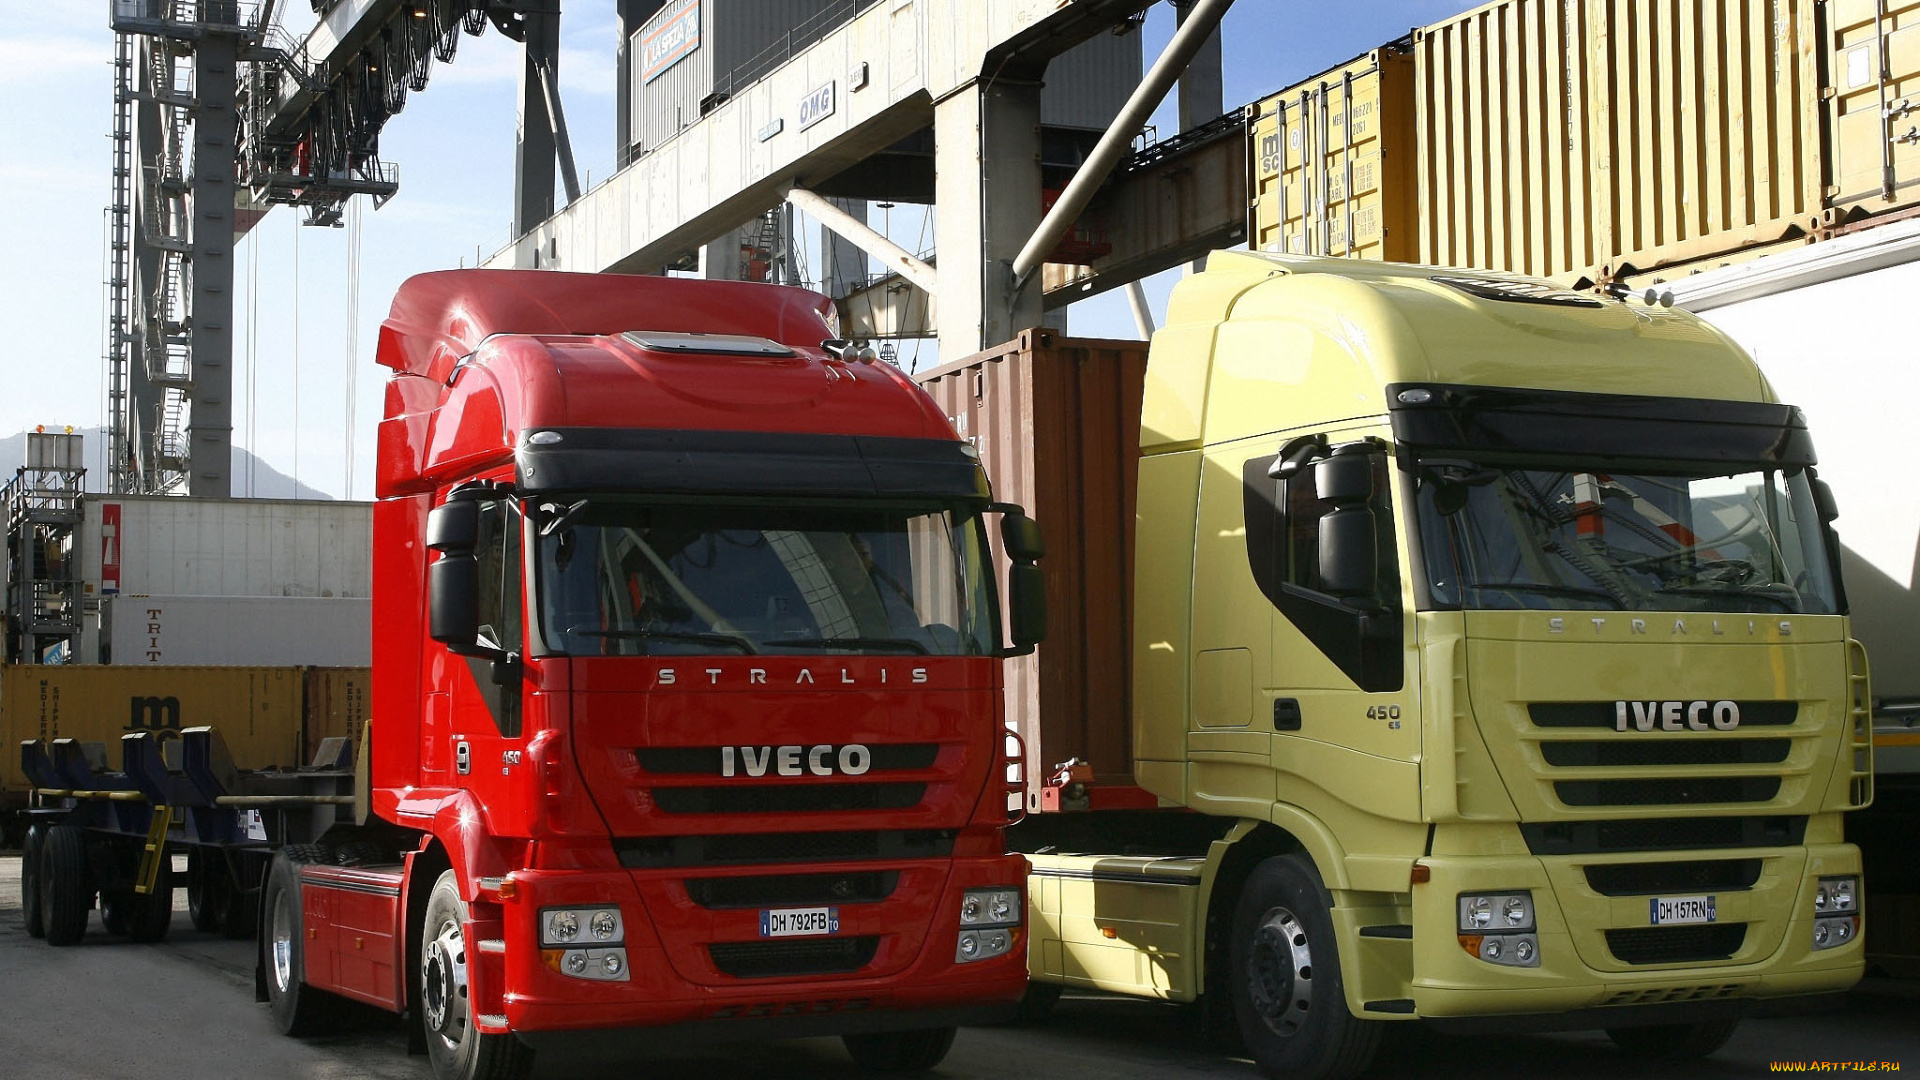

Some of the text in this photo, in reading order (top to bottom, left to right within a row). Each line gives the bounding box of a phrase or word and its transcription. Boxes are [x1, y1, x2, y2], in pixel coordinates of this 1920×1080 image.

[800, 88, 829, 124] OMG
[147, 609, 162, 662] TRIT
[1550, 618, 1792, 636] STRALIS
[658, 668, 928, 684] STRALIS
[1366, 704, 1401, 720] 450
[1615, 700, 1740, 732] IVECO
[502, 750, 520, 766] 450
[722, 744, 871, 777] IVECO
[1660, 902, 1673, 920] DH
[1674, 900, 1706, 919] 157RN
[771, 914, 787, 932] DH
[790, 912, 827, 931] 792FB
[829, 920, 839, 931] TO
